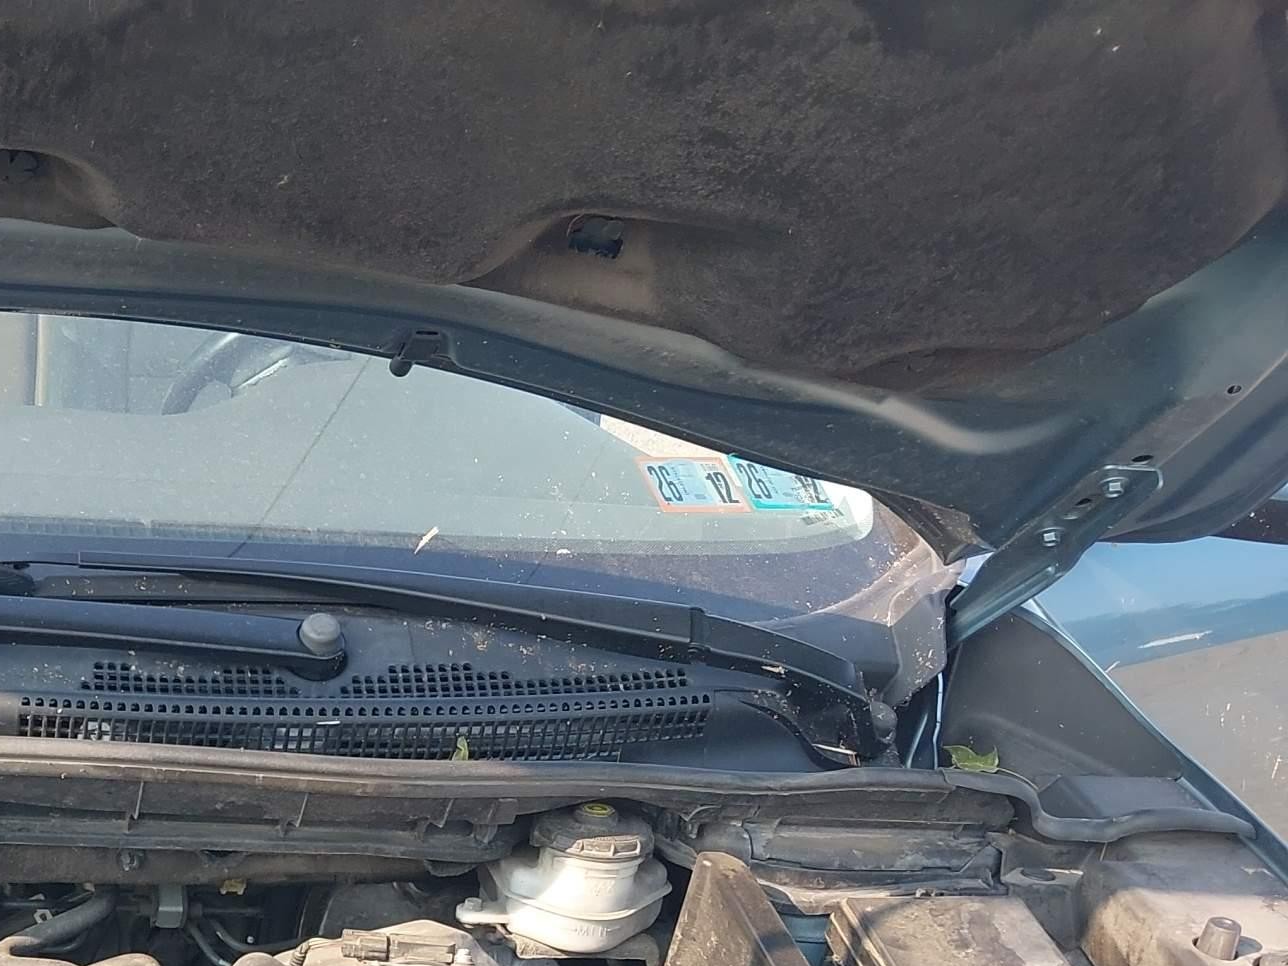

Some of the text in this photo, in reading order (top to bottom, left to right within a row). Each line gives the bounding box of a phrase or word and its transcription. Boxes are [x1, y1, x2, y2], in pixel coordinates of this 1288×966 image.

[647, 465, 684, 502] 26
[705, 471, 740, 503] 12
[736, 463, 772, 499] 26
